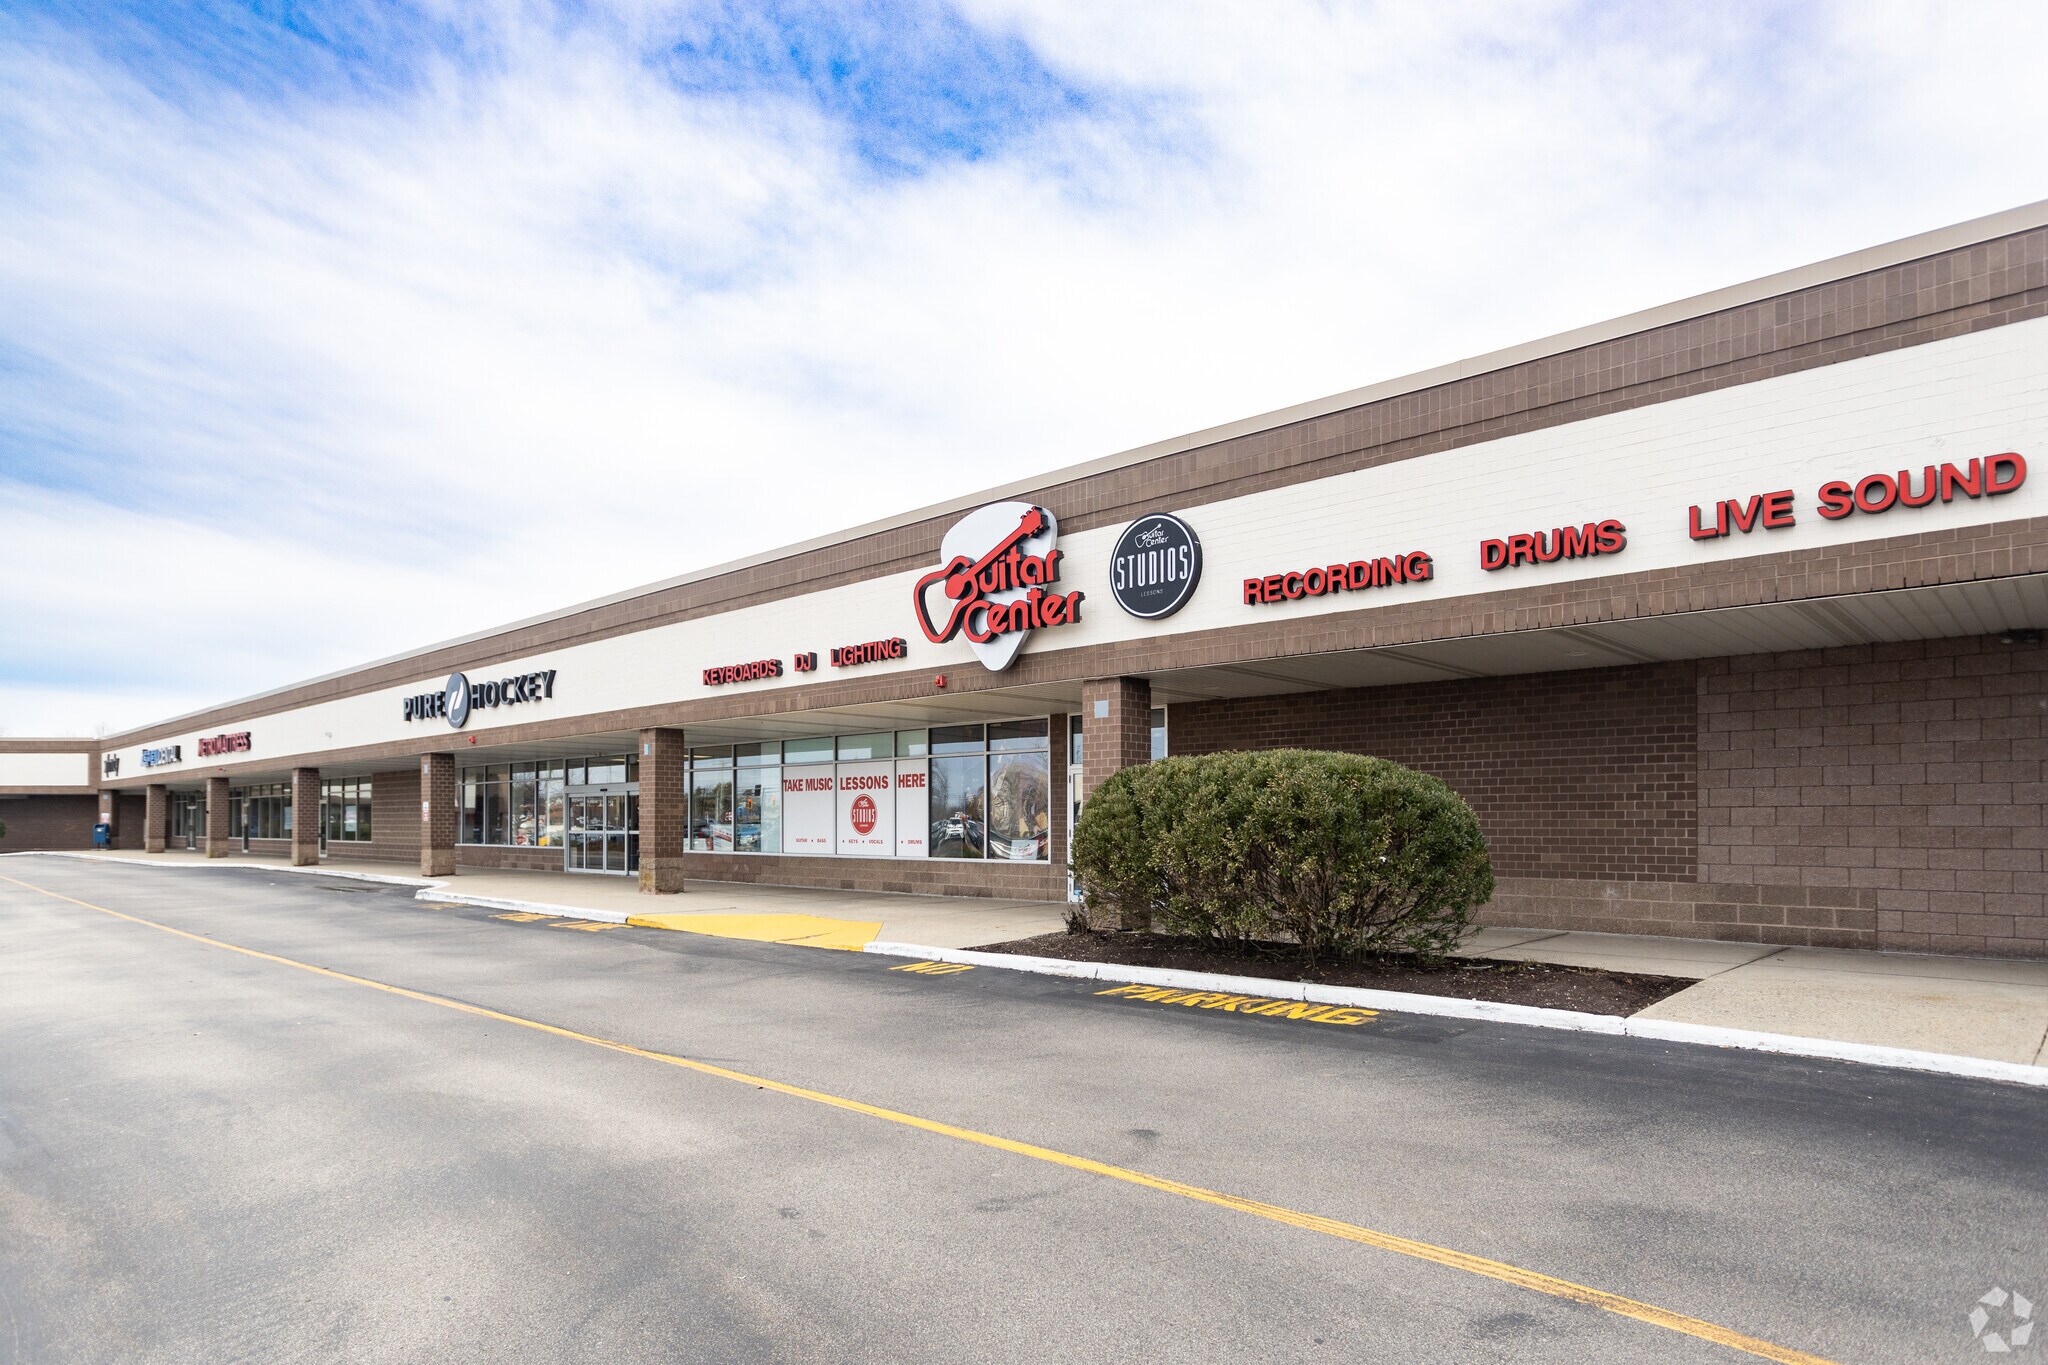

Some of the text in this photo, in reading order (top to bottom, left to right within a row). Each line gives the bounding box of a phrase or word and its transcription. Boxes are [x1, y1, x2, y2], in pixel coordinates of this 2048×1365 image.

[1135, 523, 1165, 548] Guitar
[1145, 534, 1169, 548] Center
[1243, 452, 2027, 605] RECORDING DRUMS LIVE SOUND
[1116, 545, 1188, 591] STUDIOS
[1140, 588, 1164, 598] LESSONS
[963, 588, 1084, 644] Center
[703, 637, 907, 686] KEYBOARDS DJ LIGHTING
[403, 669, 557, 721] PURE HOCKEY
[783, 773, 926, 792] TAKE MUSIC LESSONS HERE
[887, 961, 975, 975] NO
[1094, 985, 1381, 1026] PARKING
